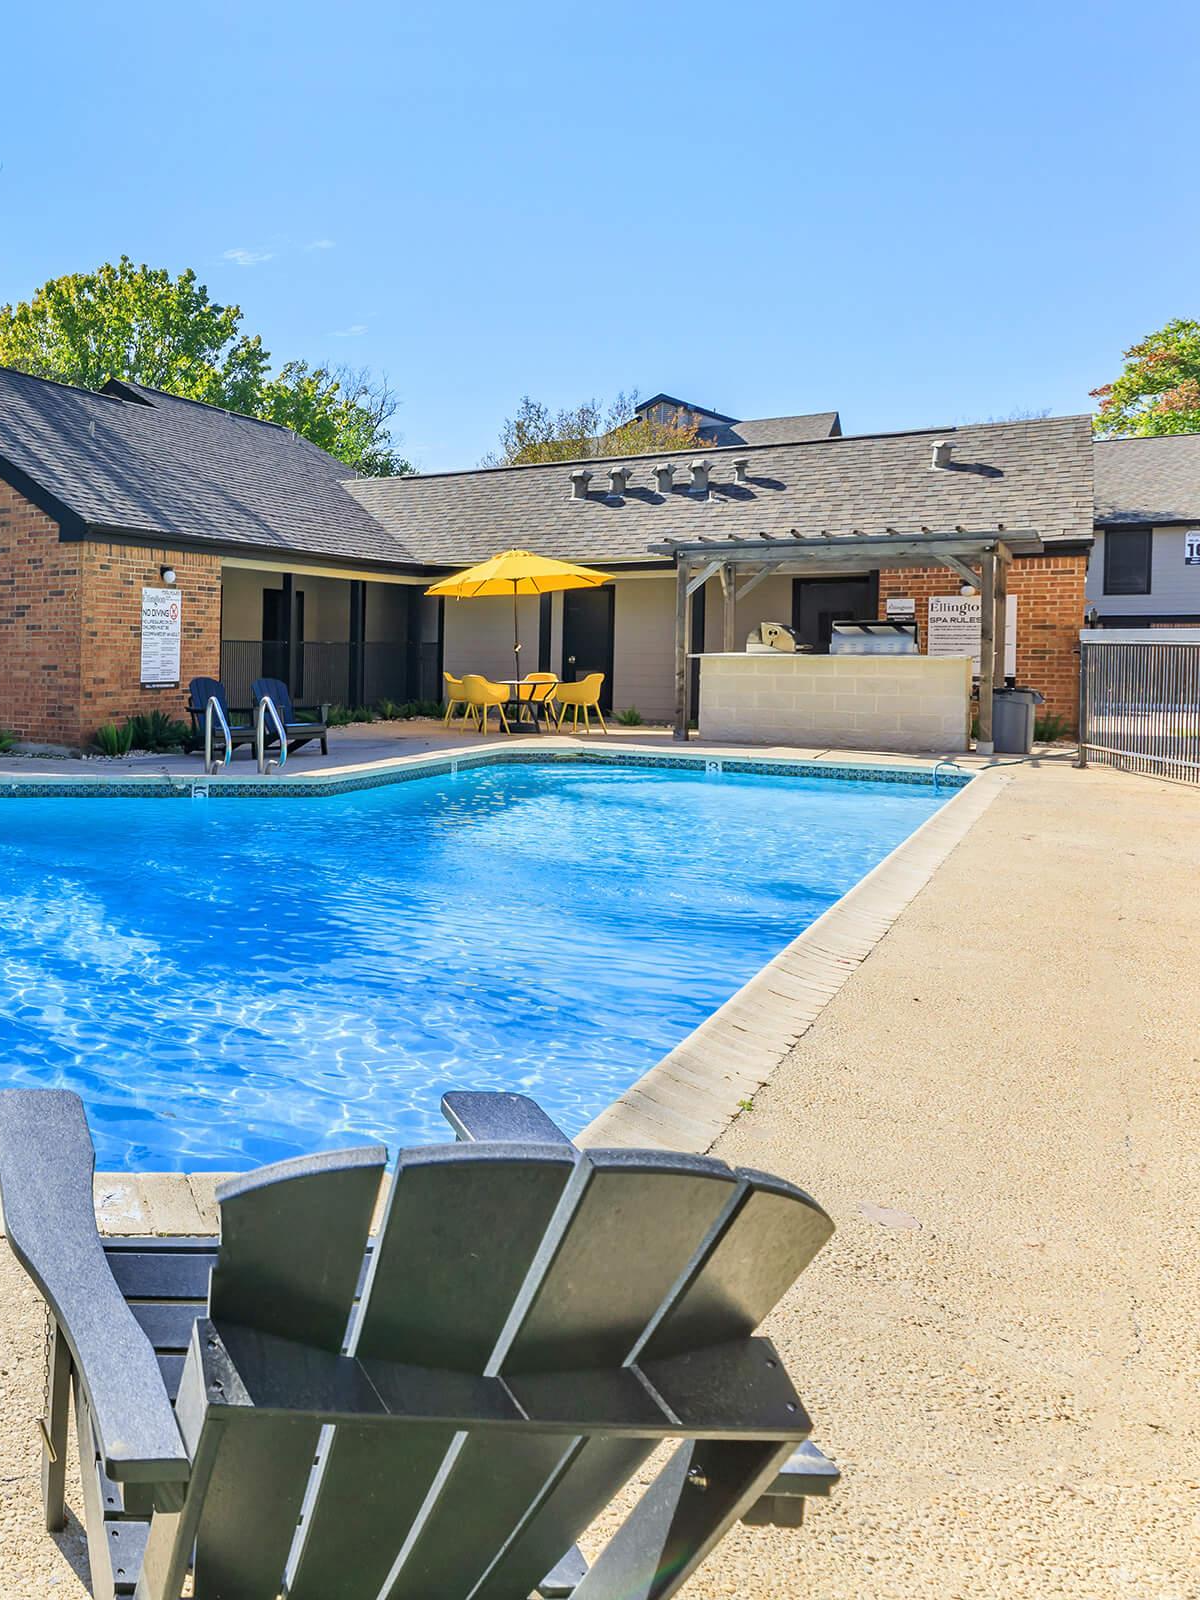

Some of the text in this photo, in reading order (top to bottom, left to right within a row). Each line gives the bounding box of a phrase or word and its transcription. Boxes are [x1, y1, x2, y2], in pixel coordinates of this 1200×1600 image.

[142, 609, 170, 617] NO DIVING
[930, 602, 980, 616] Ellingto
[193, 785, 207, 798] 5
